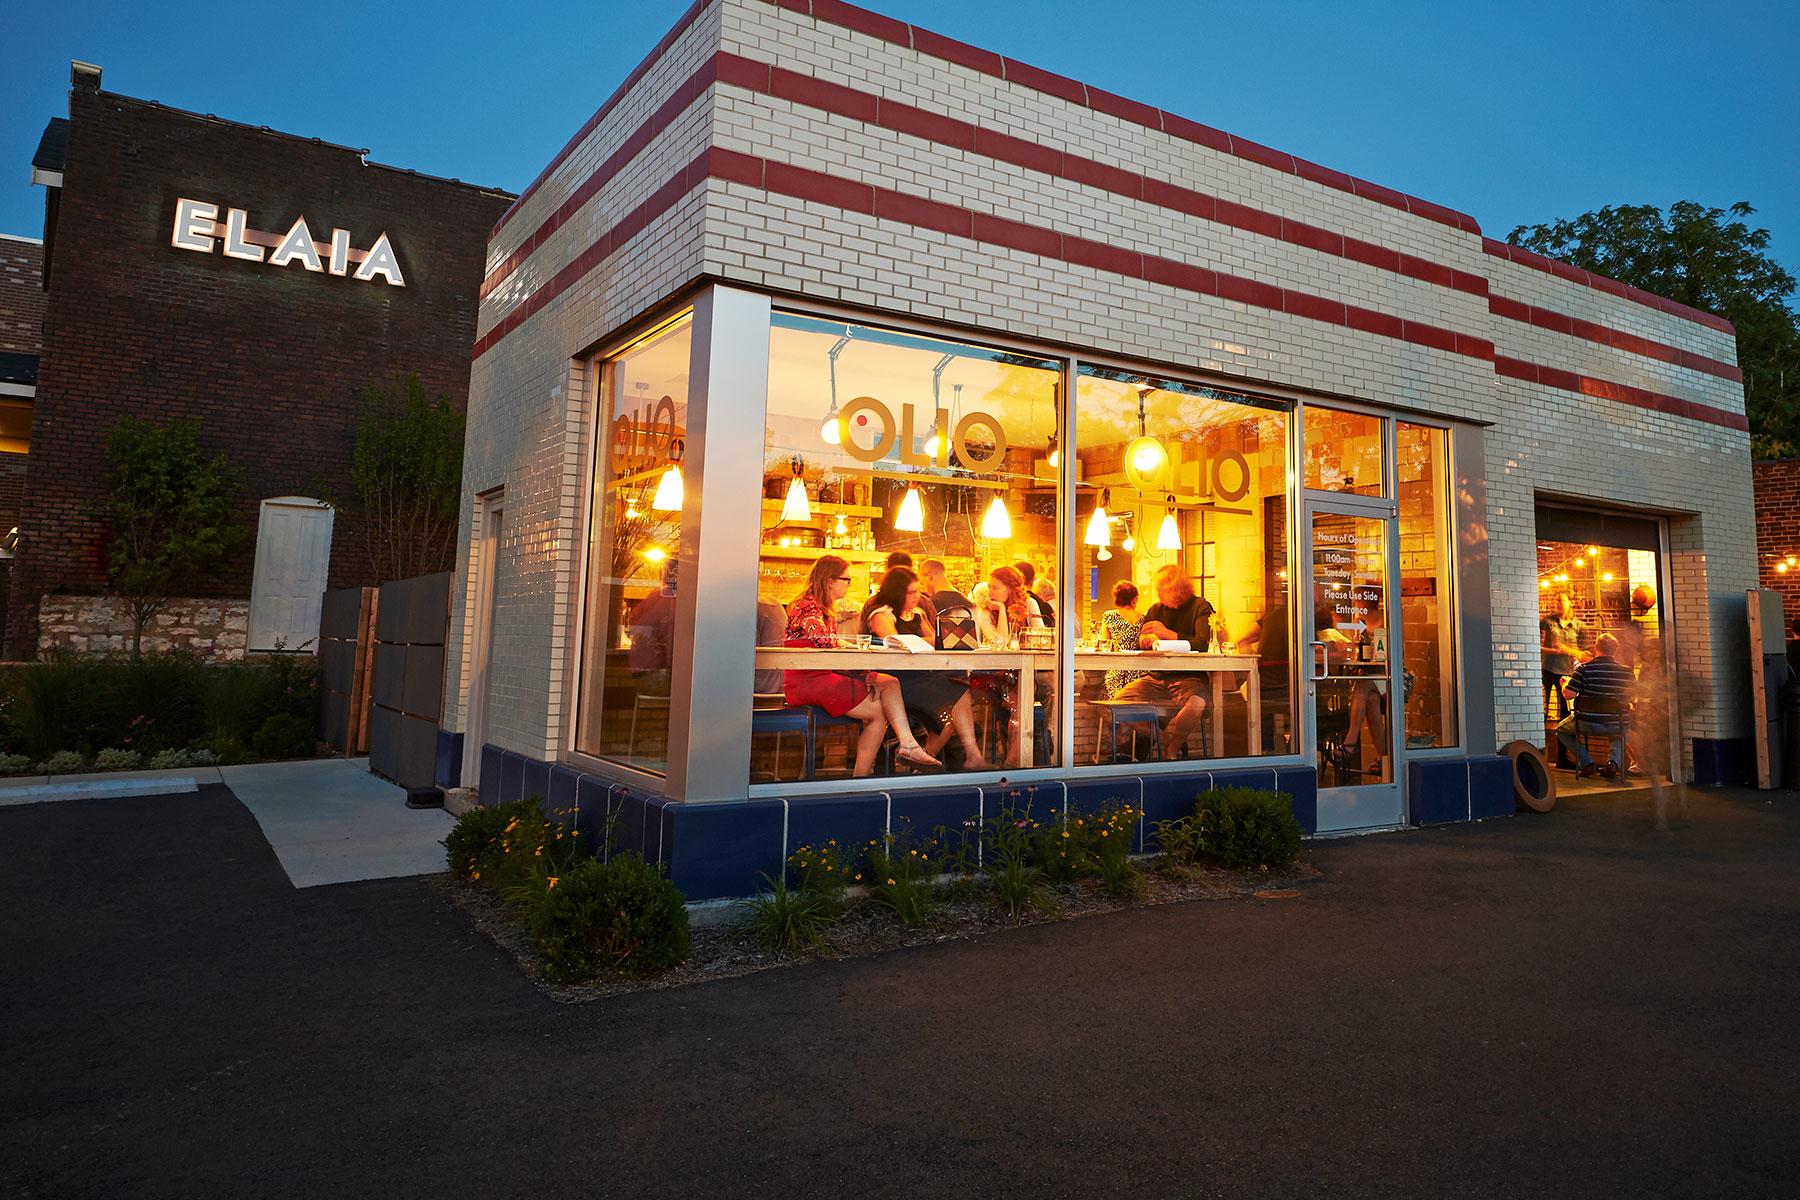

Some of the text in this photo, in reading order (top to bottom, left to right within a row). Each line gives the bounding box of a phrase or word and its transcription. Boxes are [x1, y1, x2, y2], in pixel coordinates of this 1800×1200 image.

[171, 197, 406, 287] ELAIA
[611, 395, 675, 475] OLIO
[838, 396, 1006, 473] OLIO
[1124, 436, 1250, 503] OLIO
[1317, 531, 1338, 543] Hours
[1339, 533, 1347, 543] of
[1324, 589, 1378, 601] Please Use Side
[1335, 603, 1368, 615] Entrance
[1377, 639, 1385, 652] A
